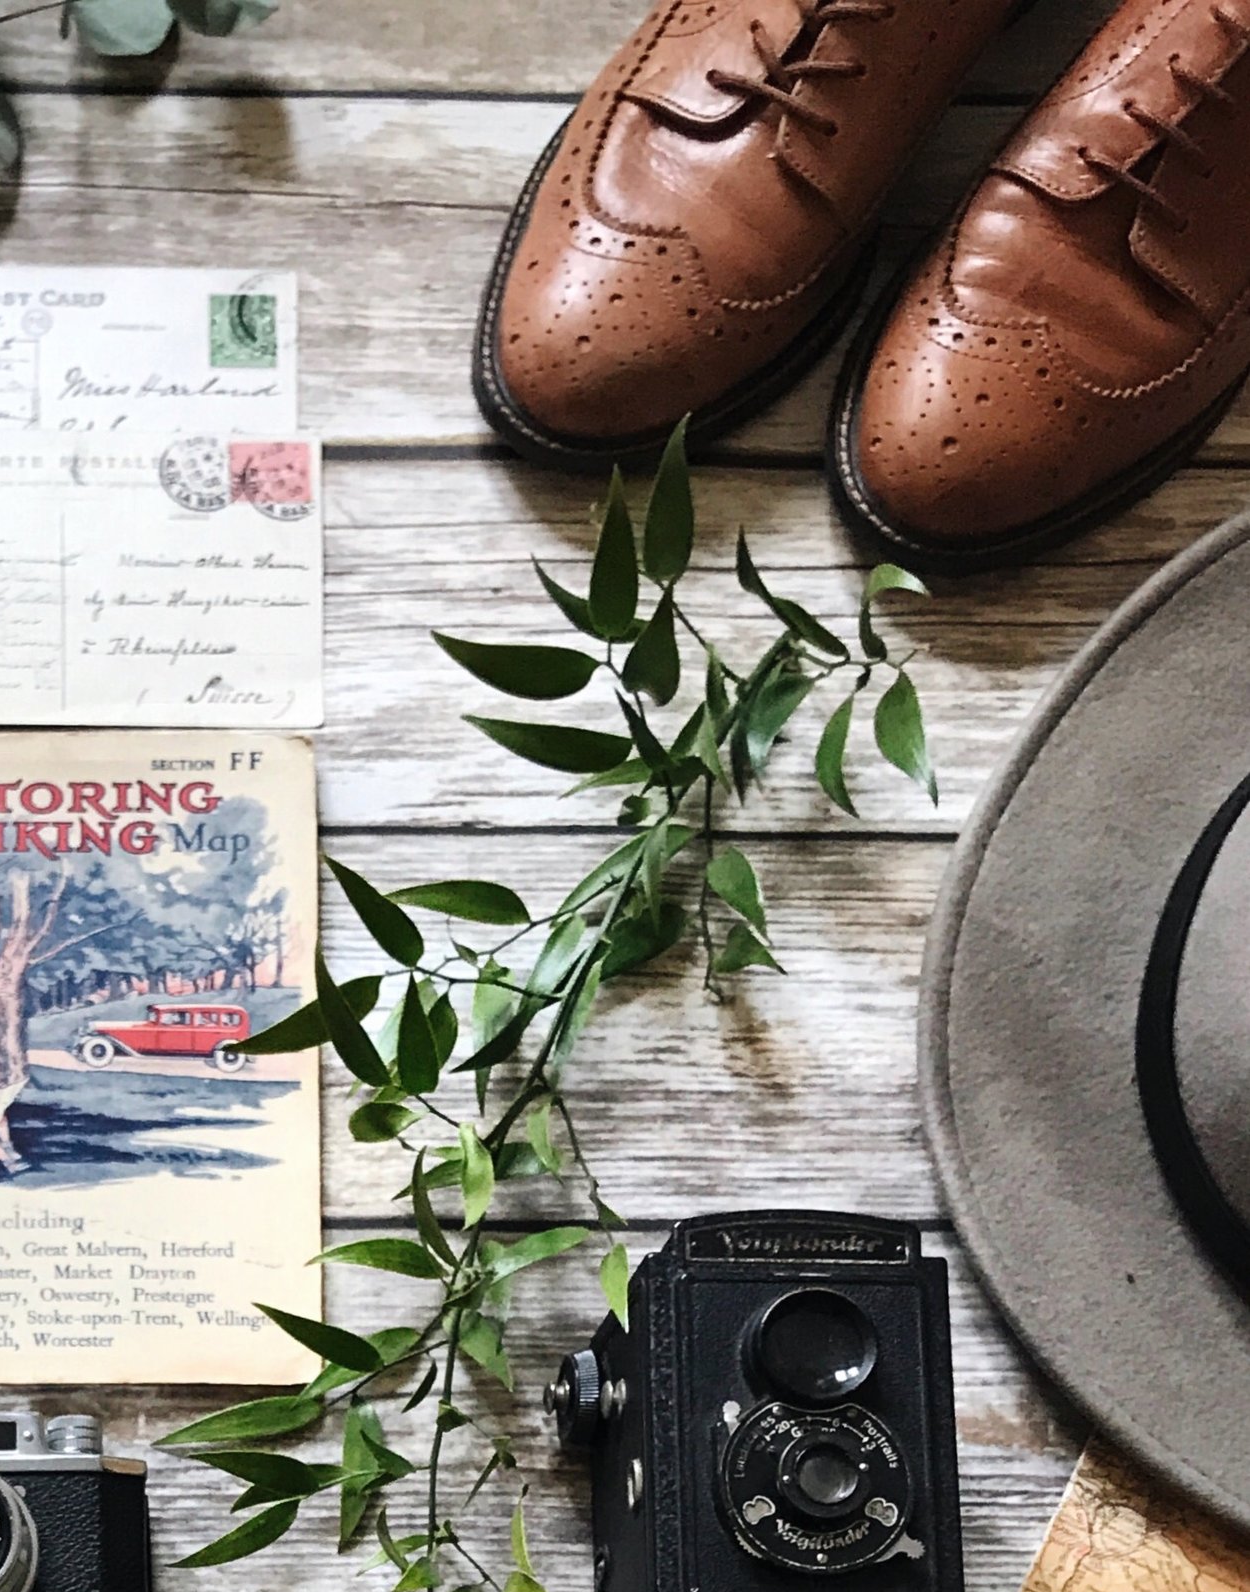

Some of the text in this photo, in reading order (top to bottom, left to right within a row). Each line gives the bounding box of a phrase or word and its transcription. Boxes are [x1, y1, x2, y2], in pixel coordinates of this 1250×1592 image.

[151, 759, 216, 772] SECTION
[164, 822, 251, 865] Map
[22, 1241, 70, 1258] Great
[76, 1241, 149, 1260] Malvern,
[160, 1240, 236, 1258] Hereford
[54, 1263, 113, 1281] Market
[129, 1263, 197, 1285] Drayton
[39, 1286, 121, 1306] Oswestry,
[133, 1286, 216, 1306] Presteigne
[26, 1309, 185, 1330] Stoke-upon-Trent,
[32, 1331, 115, 1349] Worcester
